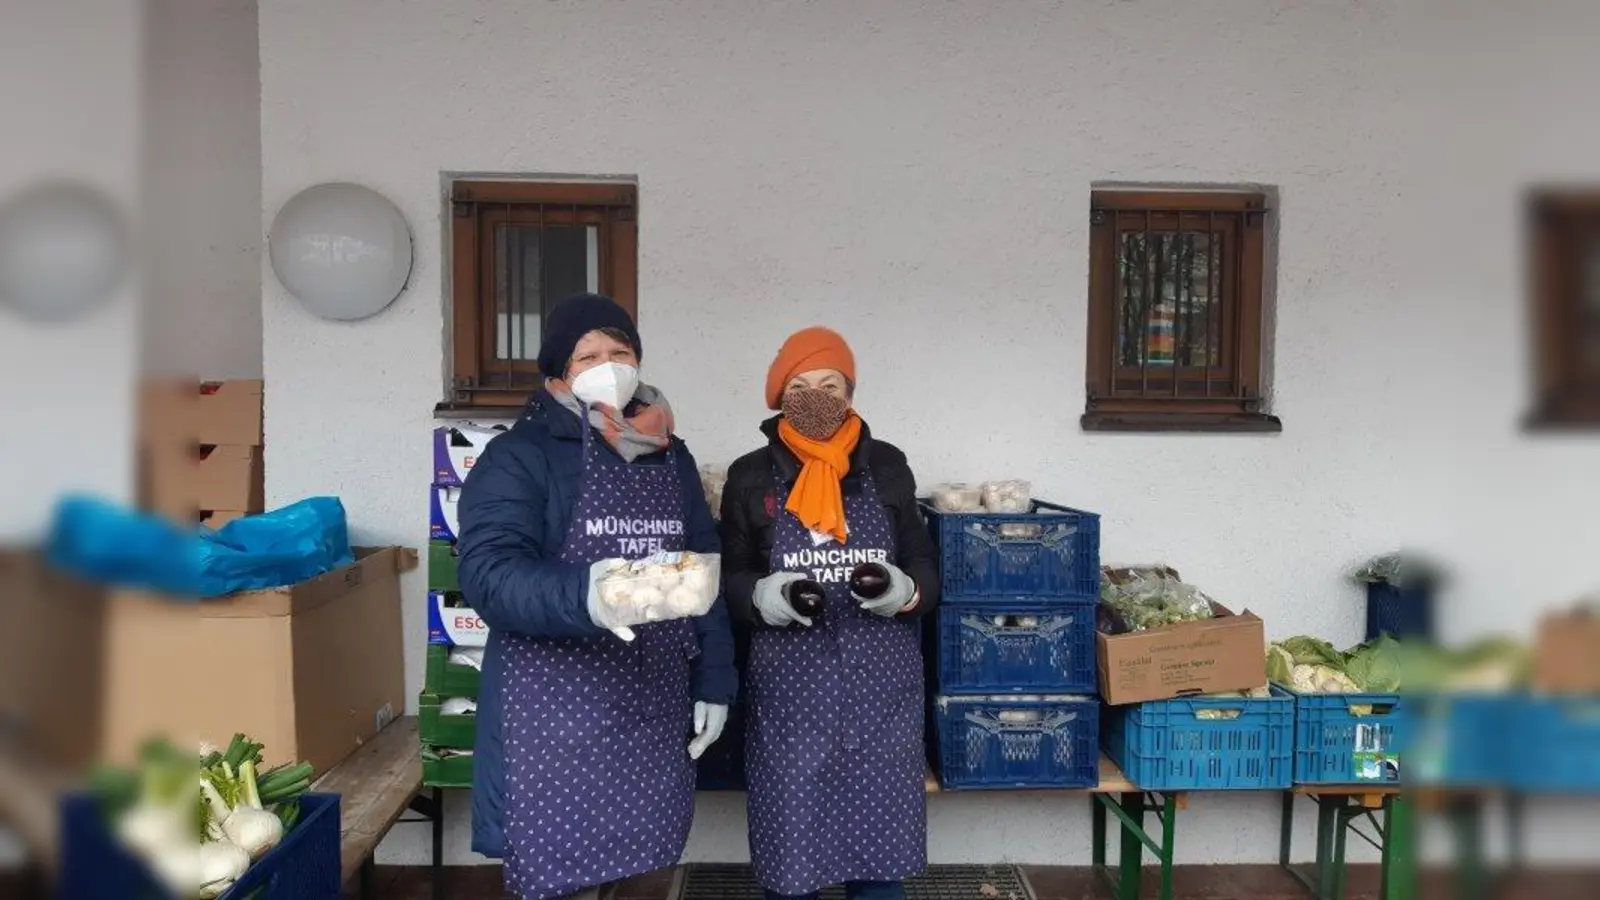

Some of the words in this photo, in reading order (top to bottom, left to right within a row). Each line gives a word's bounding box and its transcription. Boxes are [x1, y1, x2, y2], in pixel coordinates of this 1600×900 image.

[586, 515, 683, 535] MÜNCHNER
[783, 548, 887, 568] MÜNCHNER
[812, 566, 855, 582] TAFE
